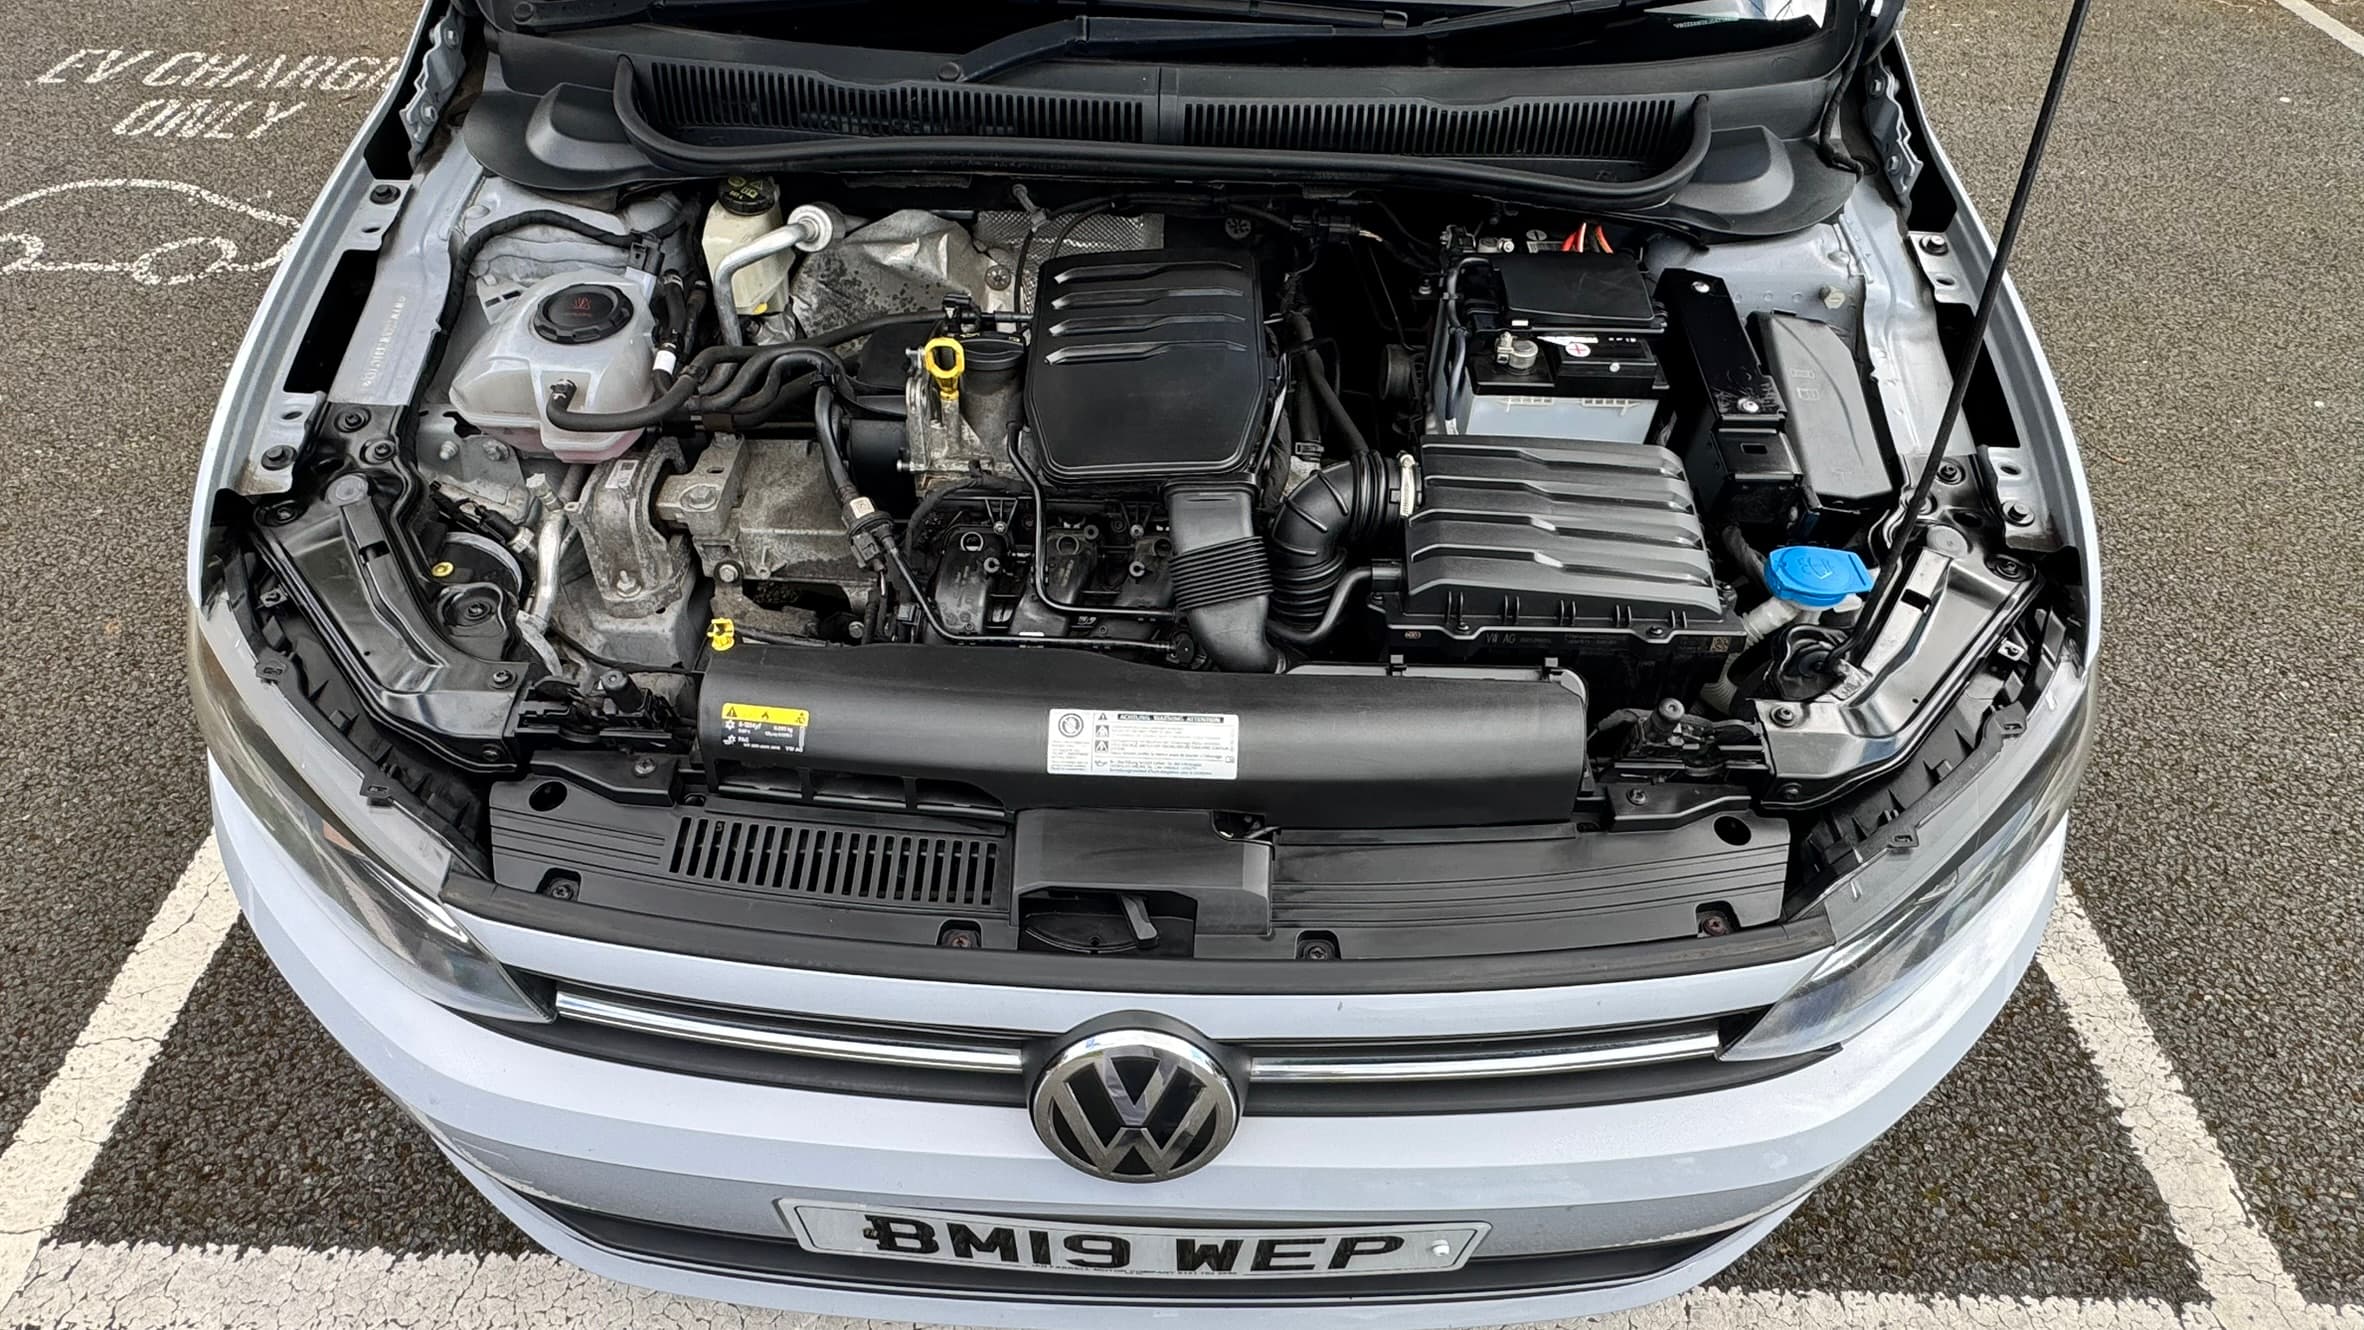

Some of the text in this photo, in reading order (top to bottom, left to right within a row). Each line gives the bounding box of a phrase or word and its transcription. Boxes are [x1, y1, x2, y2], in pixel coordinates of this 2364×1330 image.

[37, 49, 400, 91] EV CHARGI
[111, 98, 307, 139] ONLY
[1040, 1045, 1228, 1179] VW
[864, 1214, 1405, 1272] BM19 WEP
